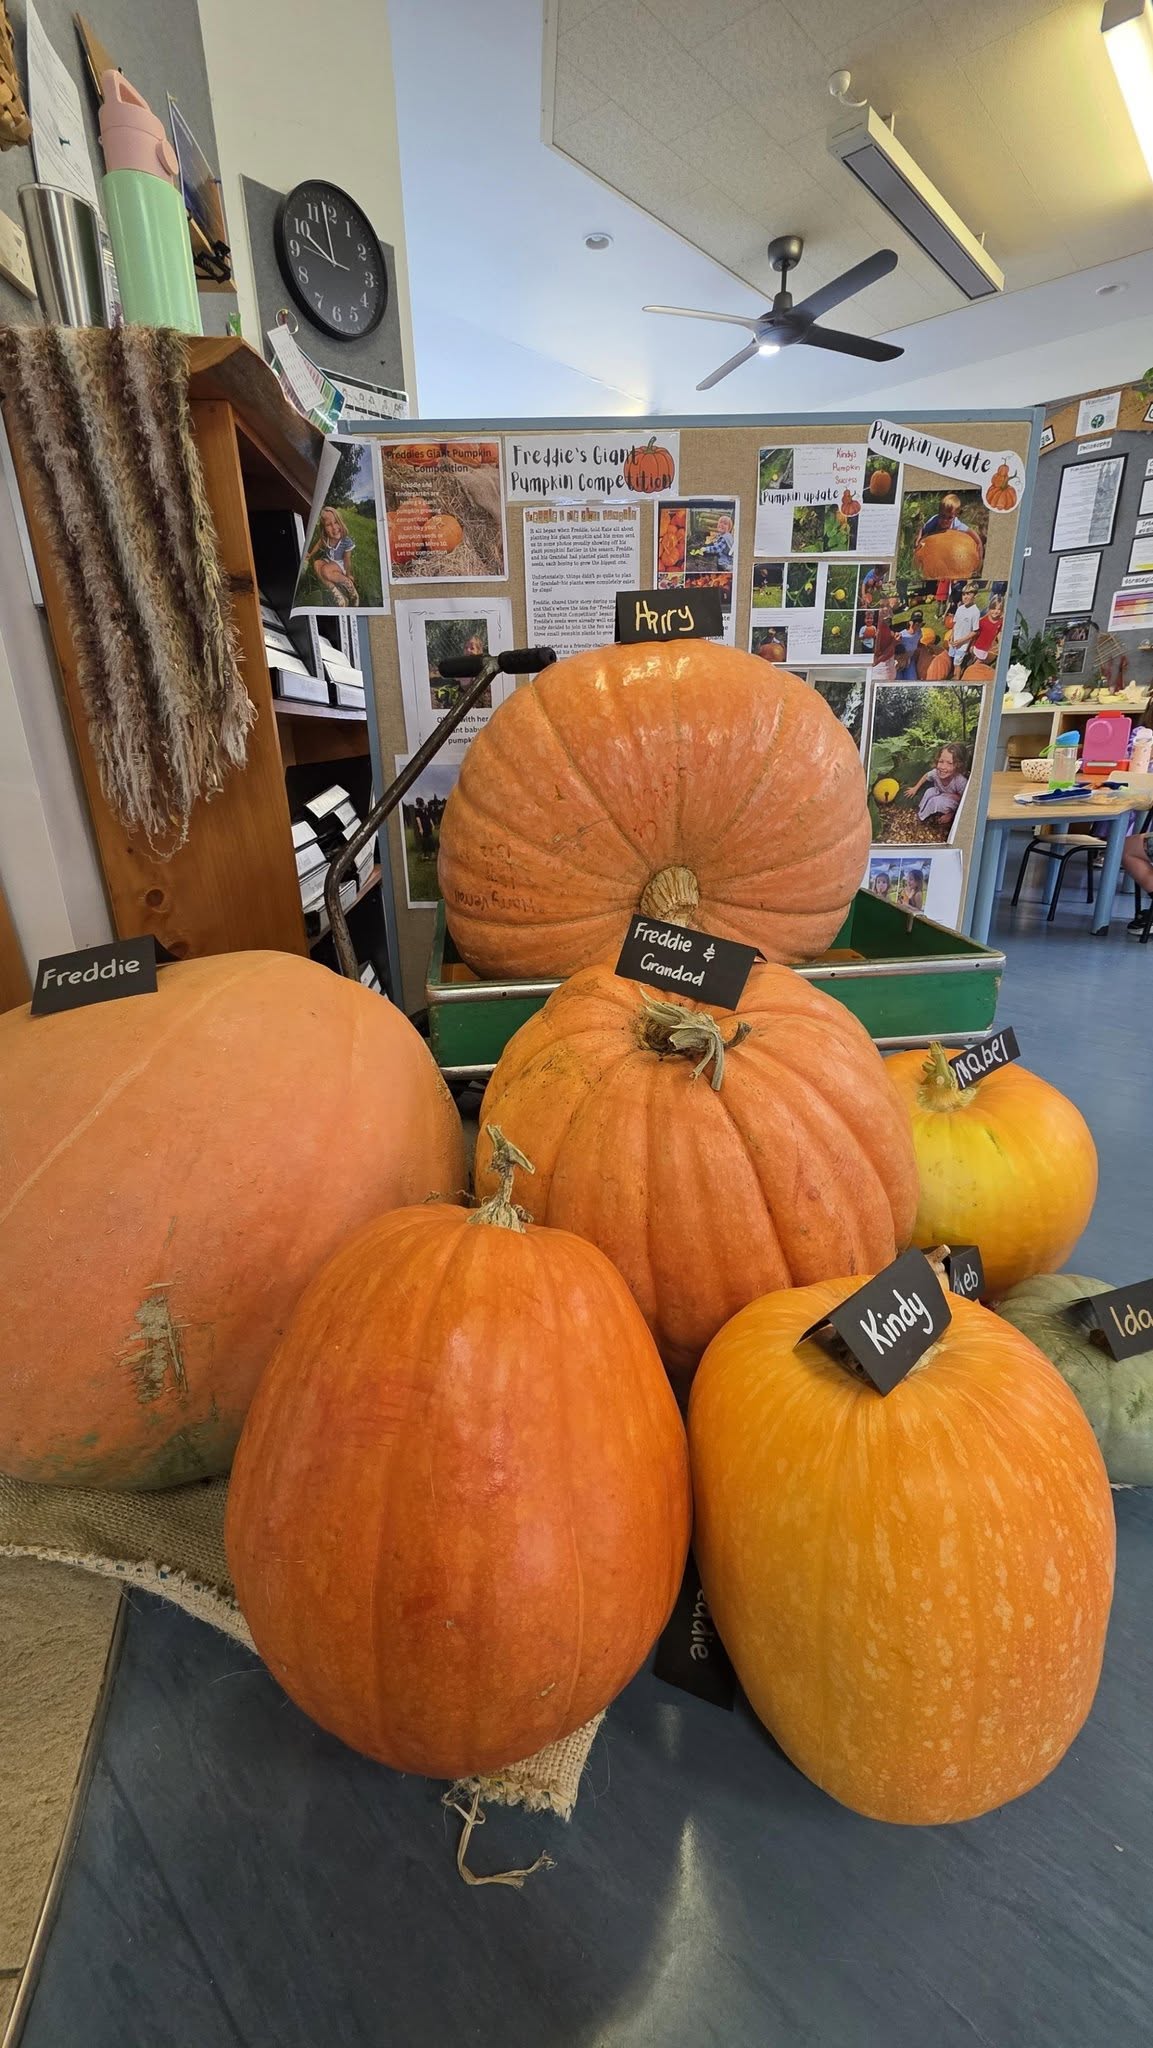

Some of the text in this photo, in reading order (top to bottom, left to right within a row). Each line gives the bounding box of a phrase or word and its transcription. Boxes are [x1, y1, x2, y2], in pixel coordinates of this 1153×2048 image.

[308, 203, 320, 223] 11
[295, 218, 310, 237] 10
[345, 221, 351, 238] 1
[289, 240, 300, 257] 9
[357, 243, 367, 261] 2
[299, 265, 309, 284] 8
[365, 271, 374, 288] 3
[314, 292, 324, 309] 7
[360, 291, 369, 308] 4
[332, 306, 342, 322] 6
[350, 306, 359, 322] 5
[426, 448, 450, 458] Giant
[453, 448, 491, 459] Pumpkin
[513, 445, 639, 467] Freddie's Giant
[871, 421, 991, 473] Pumpkin update
[414, 464, 468, 473] Competition
[832, 463, 860, 472] Pumpkin
[511, 471, 673, 496] Pumpkin Competition
[763, 488, 838, 505] Pumpkin update
[635, 600, 694, 634] Harry
[634, 922, 716, 962] Freddie &
[42, 958, 140, 989] Freddie
[640, 953, 706, 987] Grandad
[955, 1034, 1009, 1088] Mabel
[860, 1289, 934, 1356] Kindy
[1109, 1304, 1153, 1337] Ida
